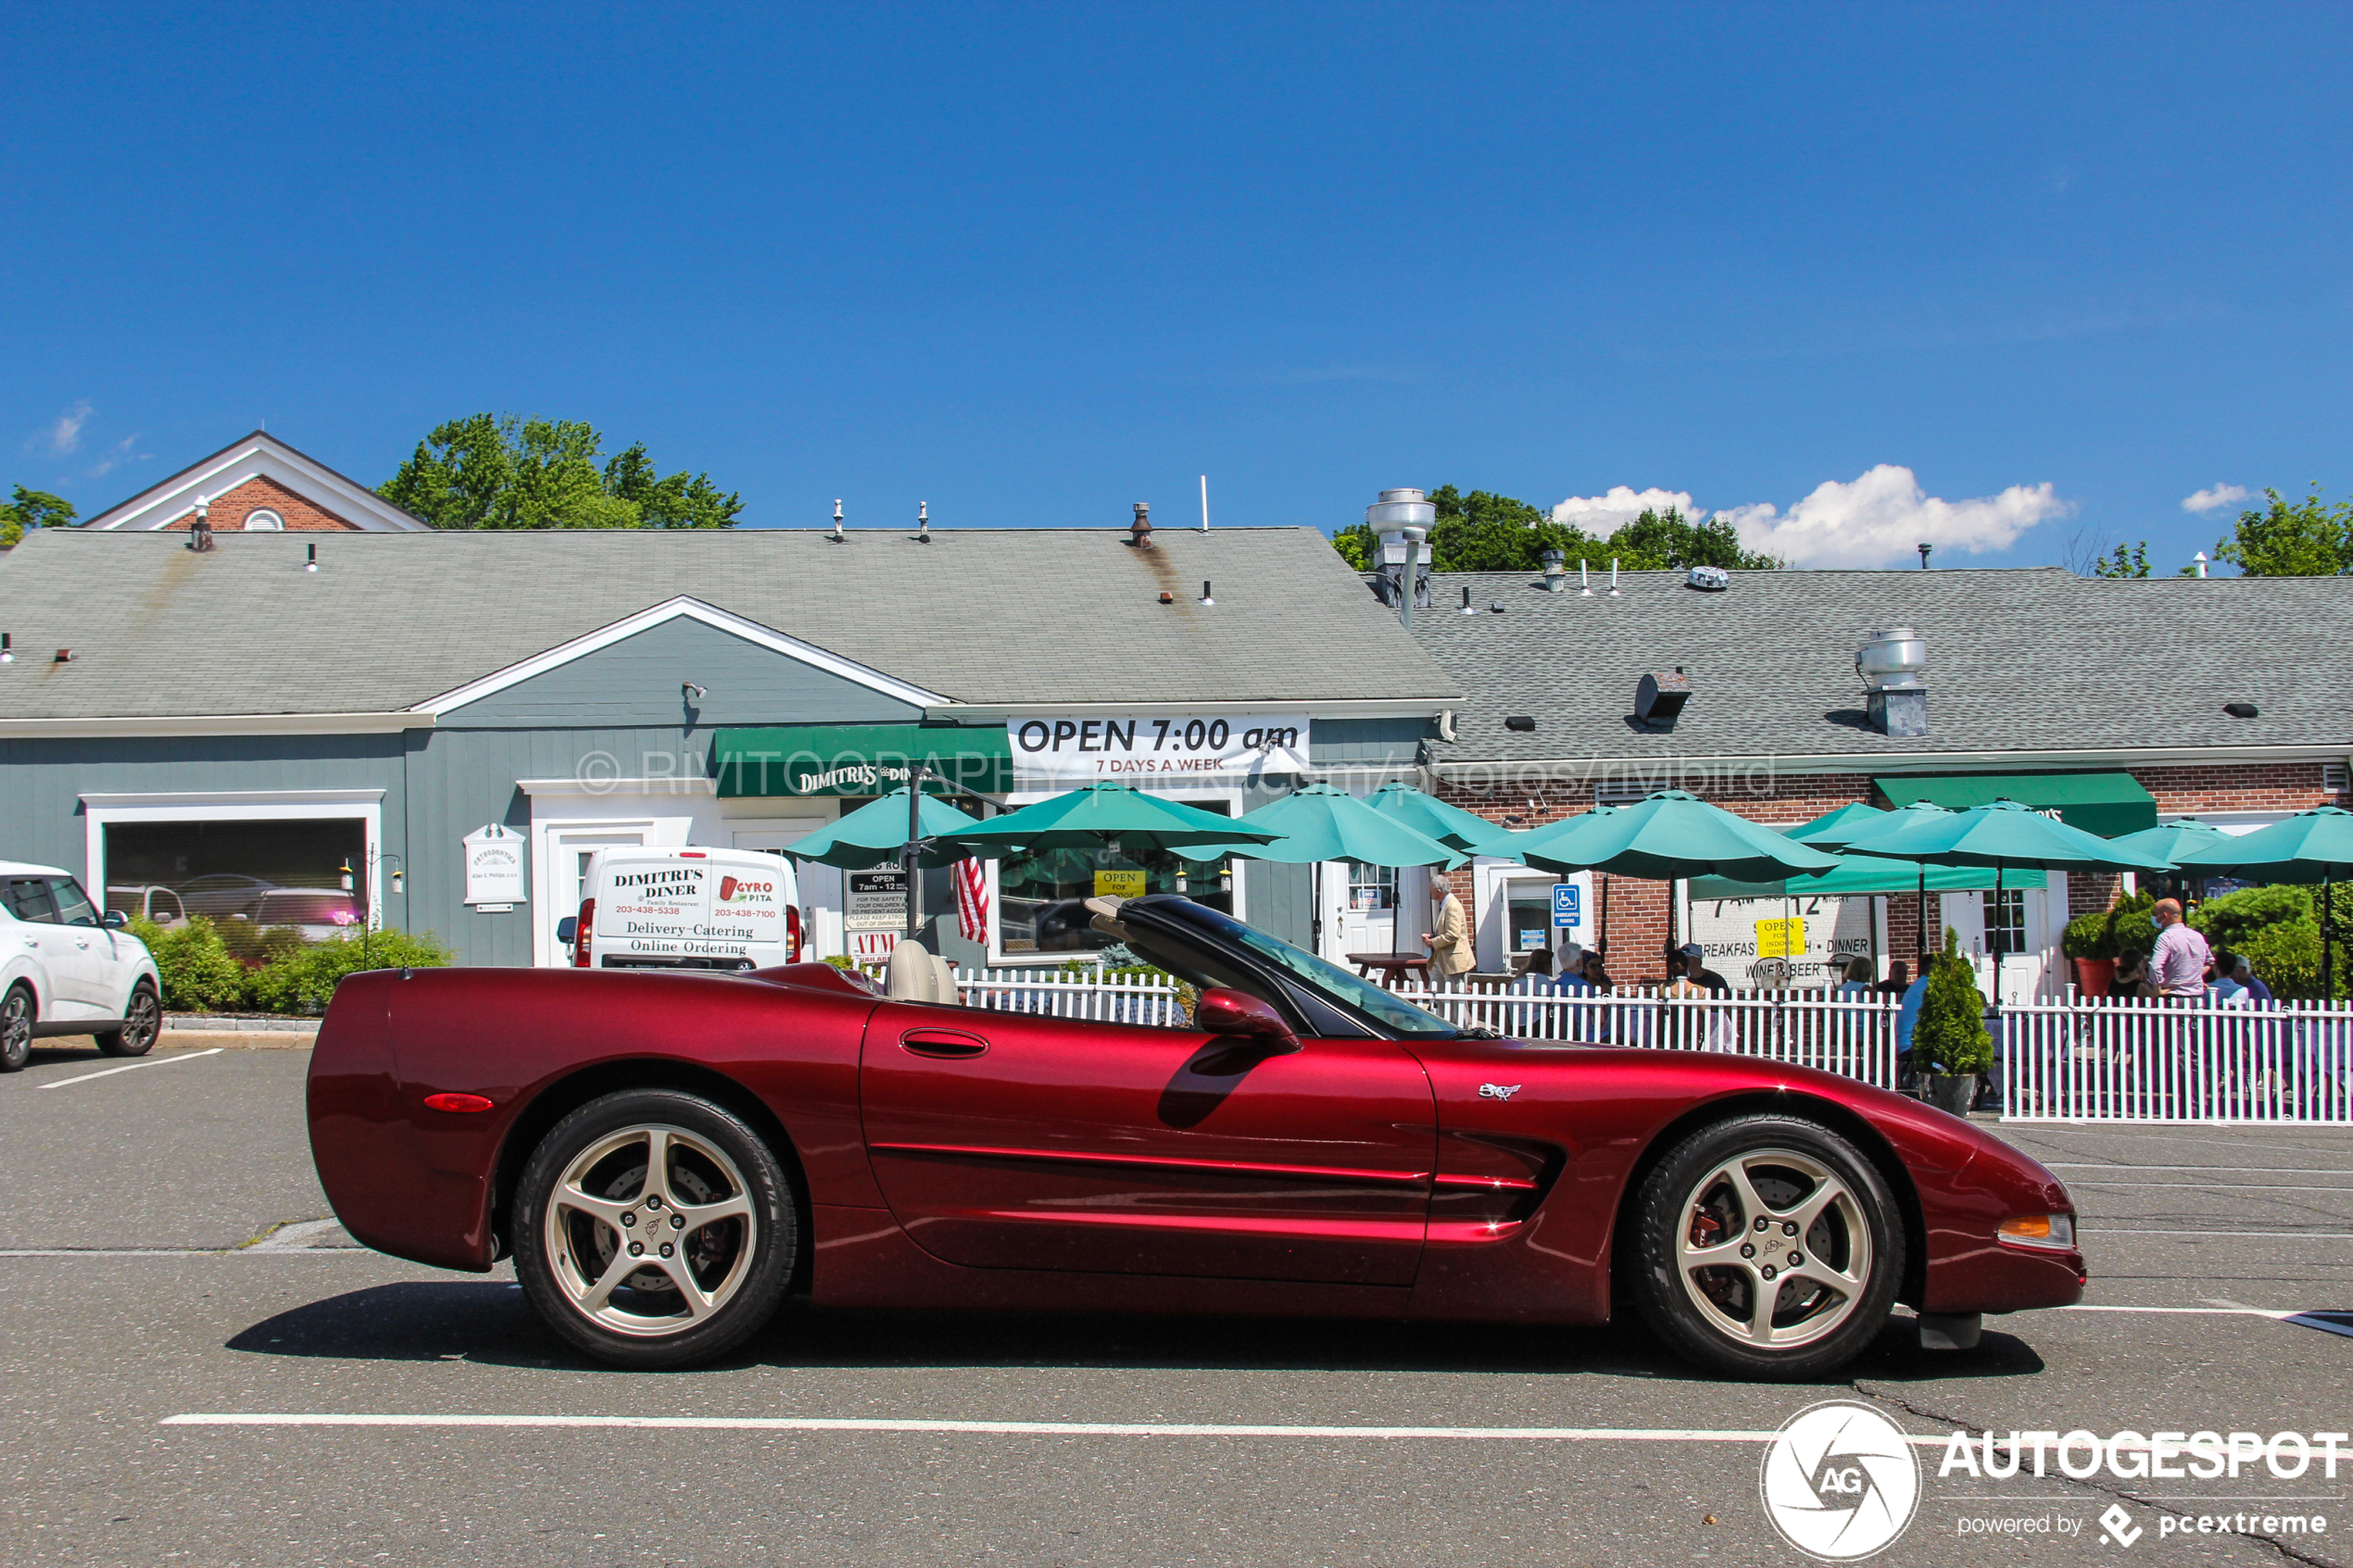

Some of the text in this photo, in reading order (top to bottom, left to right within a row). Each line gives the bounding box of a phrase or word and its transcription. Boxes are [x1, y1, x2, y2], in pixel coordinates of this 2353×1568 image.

[1018, 719, 1298, 753] OPEN 7:00 am
[1096, 758, 1224, 772] 7 DAYS A WEEK
[799, 763, 877, 793] DIMITRI'S
[473, 848, 516, 866] ORTHODONTICS
[614, 869, 704, 886] DIMITRI'S
[1103, 872, 1136, 882] OPEN
[645, 884, 698, 898] DINER
[736, 882, 774, 892] GYRO
[616, 906, 680, 915] 203-438-5338
[715, 909, 775, 918] 203-438-7100
[626, 922, 754, 939] Delivery-Catering
[1764, 922, 1794, 931] OPEN
[631, 939, 747, 956] Online Ordering
[856, 934, 894, 954] ATM
[1827, 938, 1868, 953] DINNER
[1745, 963, 1774, 978] WINE
[1790, 962, 1819, 977] BEER
